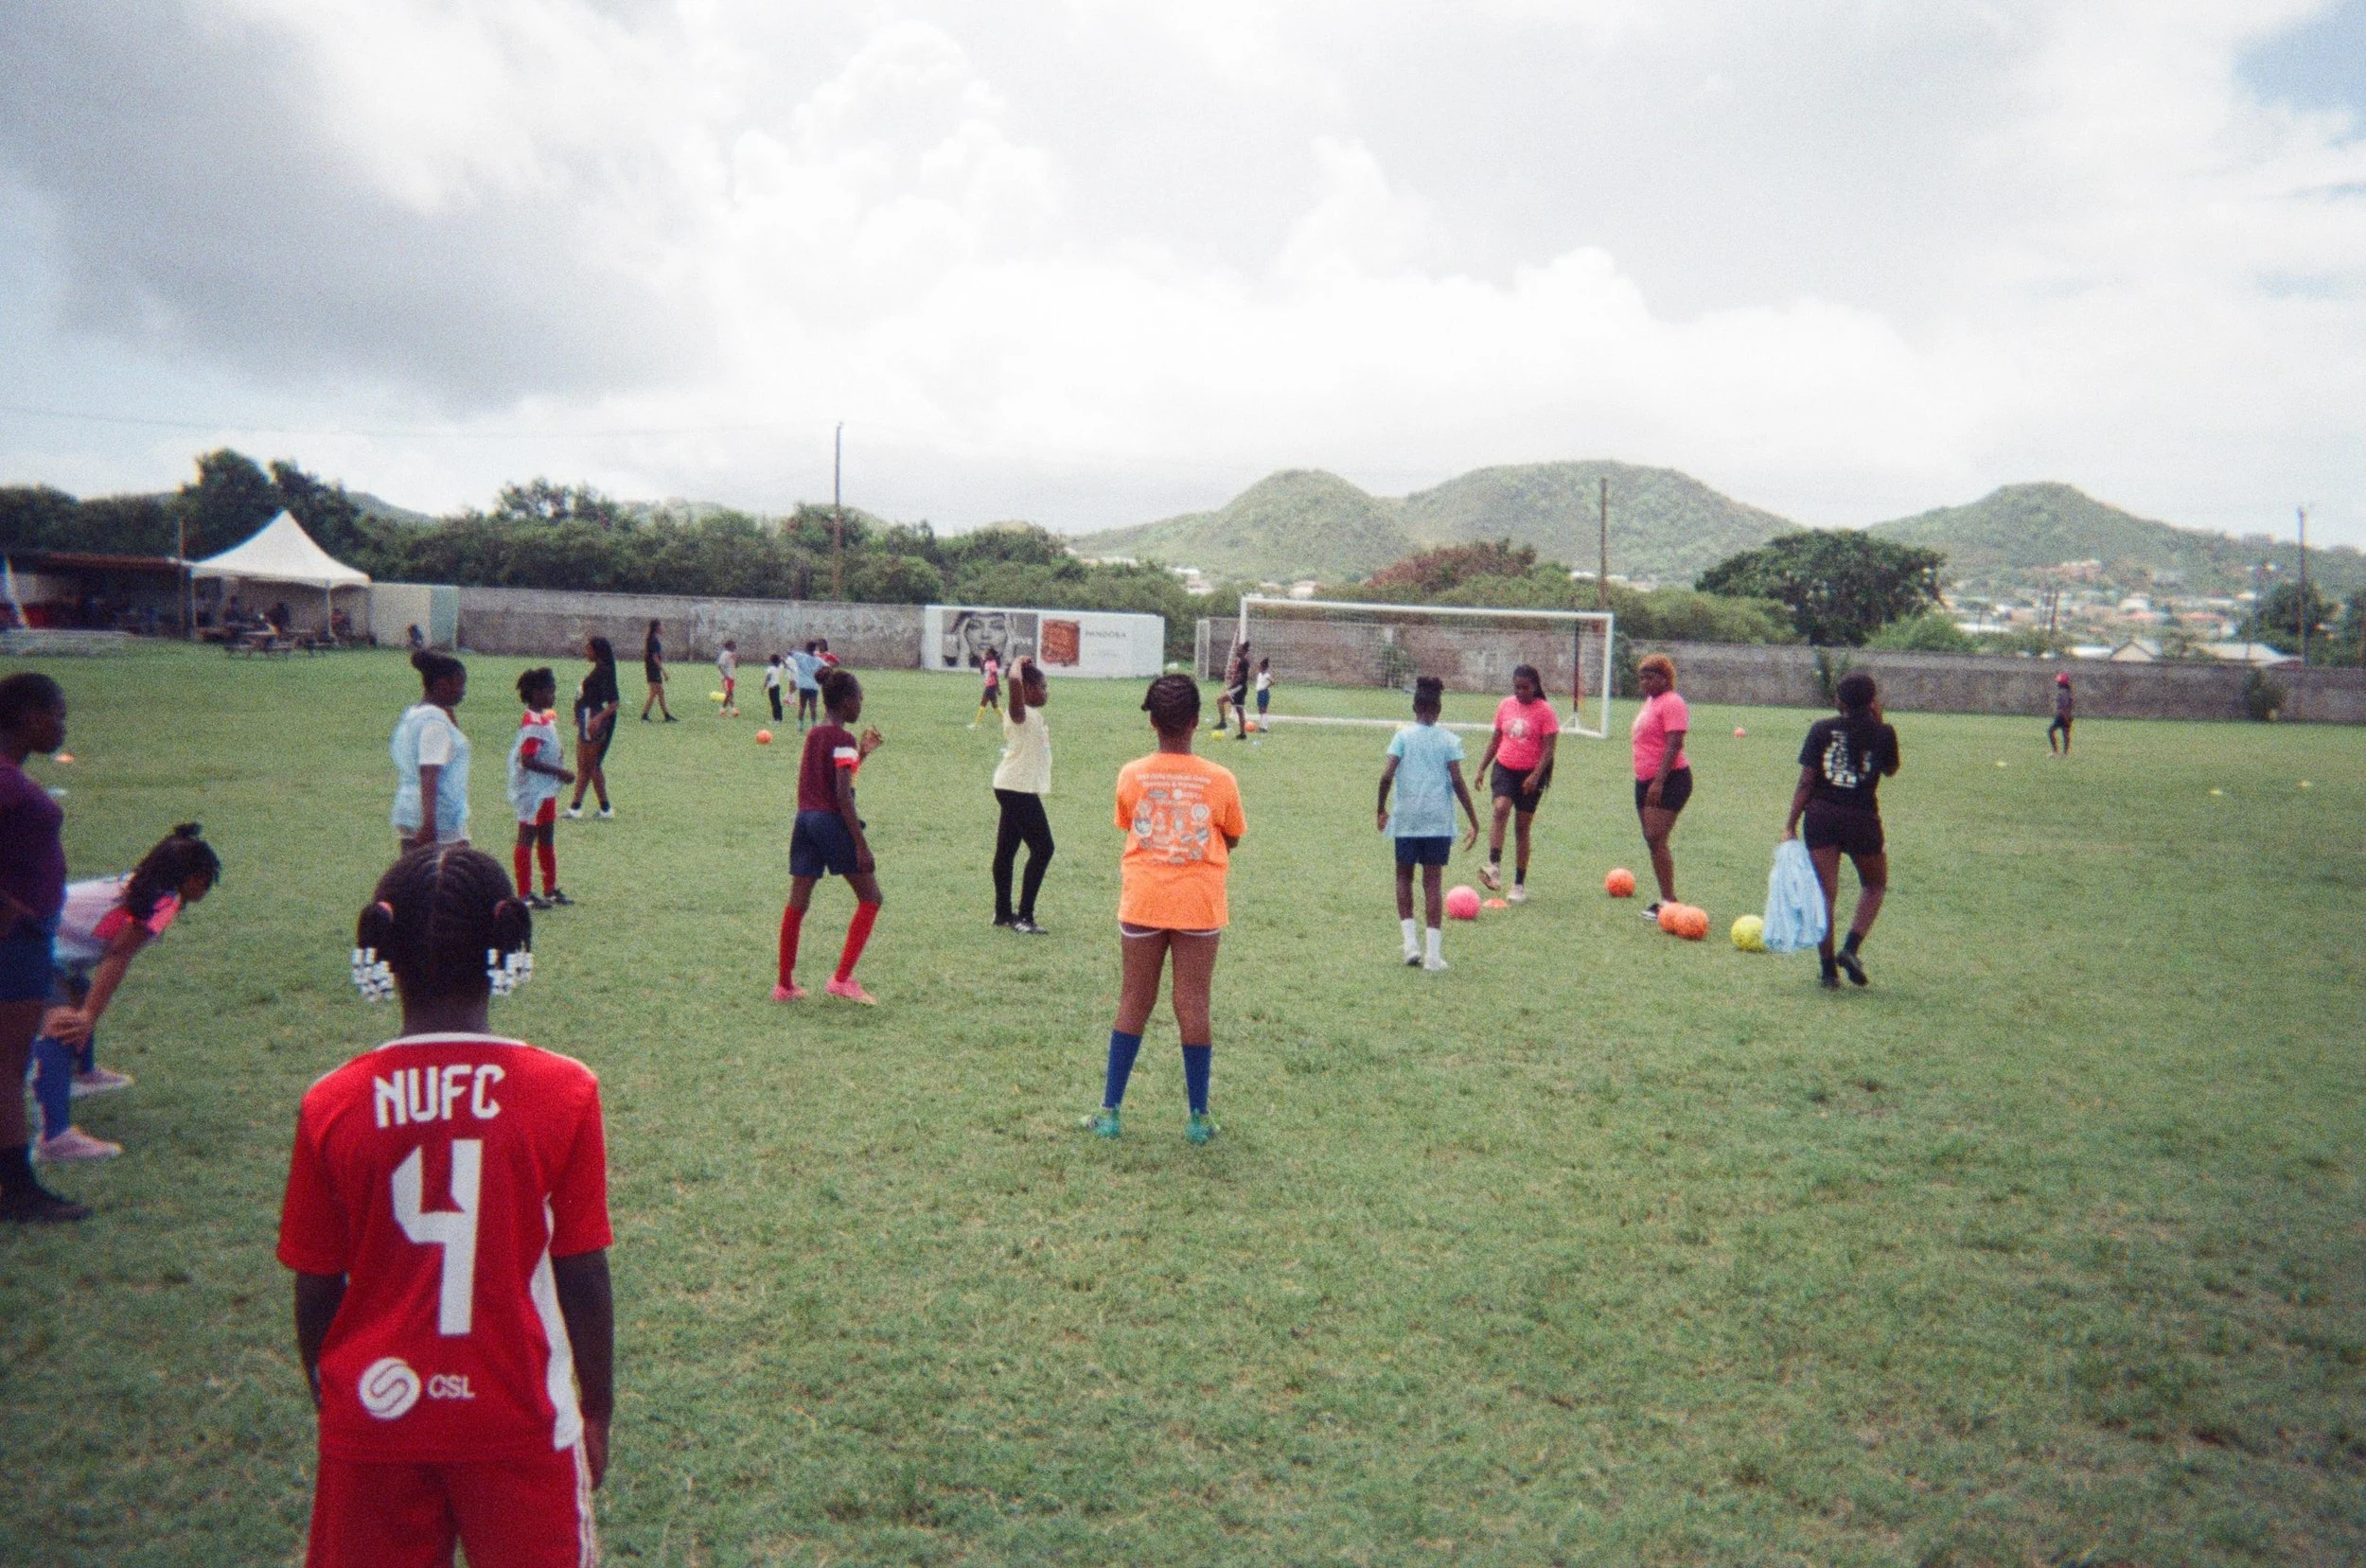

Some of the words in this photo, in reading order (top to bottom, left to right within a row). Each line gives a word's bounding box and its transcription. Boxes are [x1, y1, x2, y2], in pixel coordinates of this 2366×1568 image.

[372, 1065, 505, 1129] NUFC
[390, 1138, 483, 1336] 4
[428, 1374, 475, 1399] CSL
